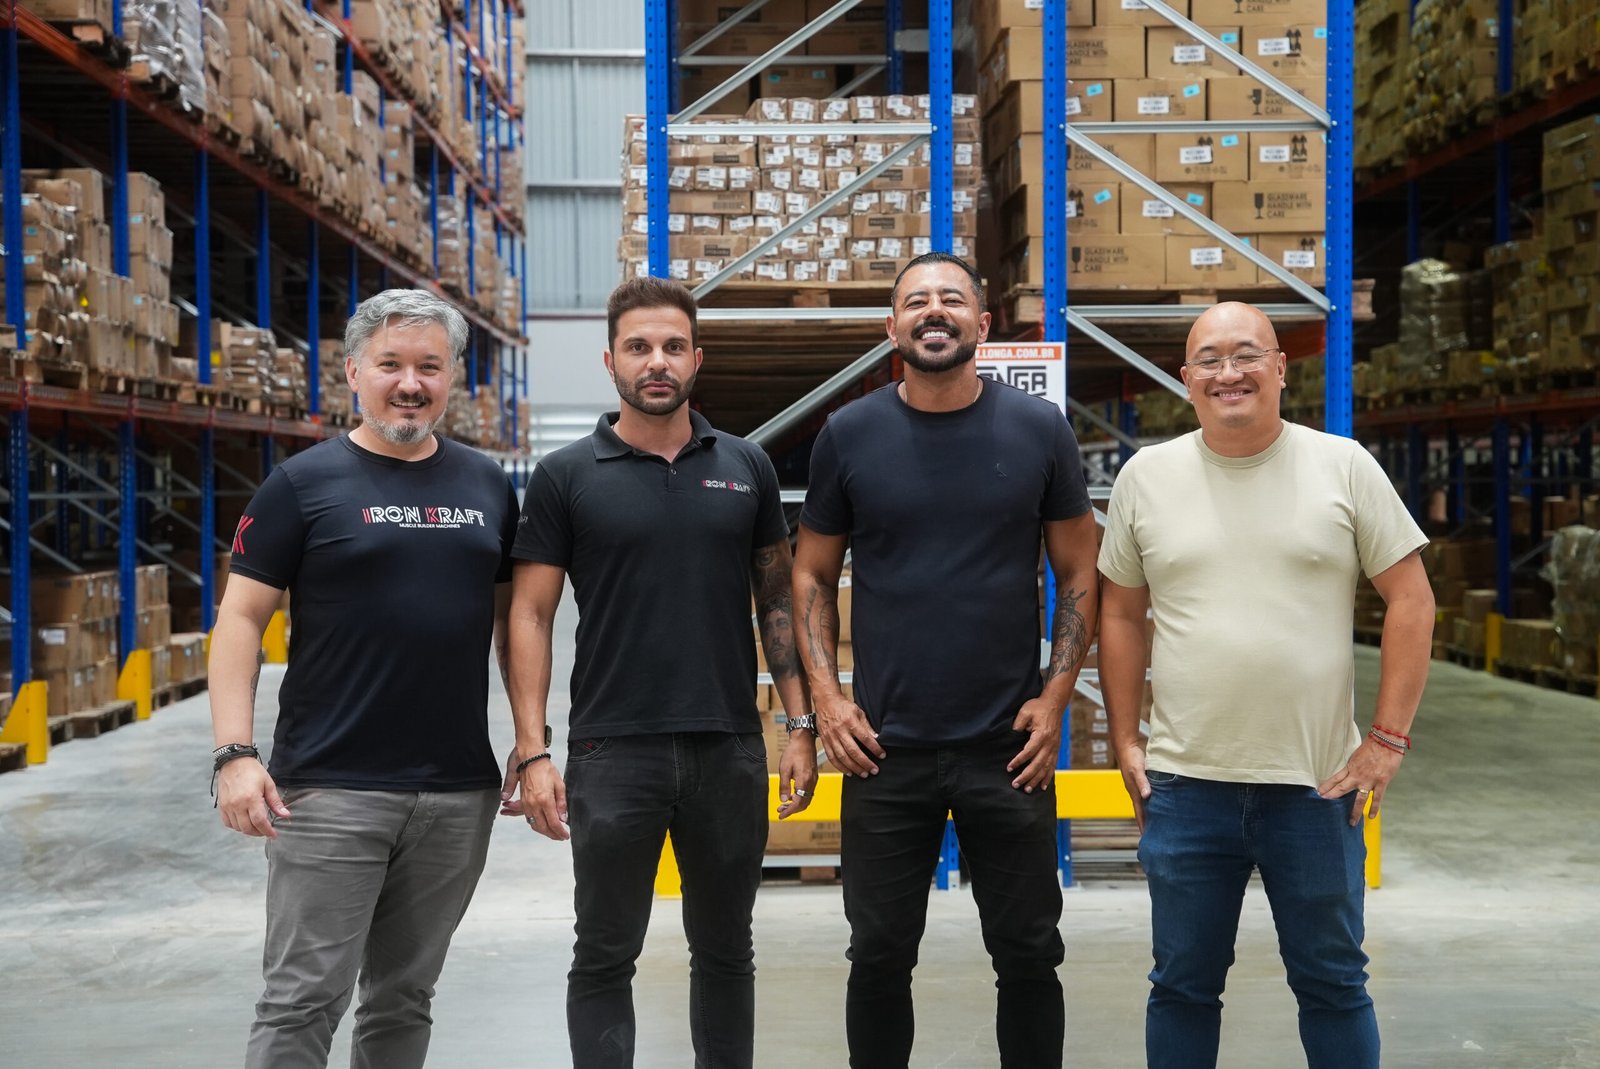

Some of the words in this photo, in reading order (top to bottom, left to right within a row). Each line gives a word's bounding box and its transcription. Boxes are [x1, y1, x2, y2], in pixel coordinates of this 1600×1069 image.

[1074, 161, 1092, 170] CARE
[1267, 192, 1307, 201] GLASSWARE
[1267, 201, 1293, 209] HANDLE
[1296, 201, 1312, 209] WITH
[1267, 210, 1285, 218] CARE
[1084, 247, 1125, 255] GLASSWARE
[1084, 256, 1110, 264] HANDLE
[1112, 256, 1129, 264] WITH
[1084, 264, 1102, 272] CARE
[362, 505, 421, 524] IRON
[425, 507, 485, 527] KRAFT
